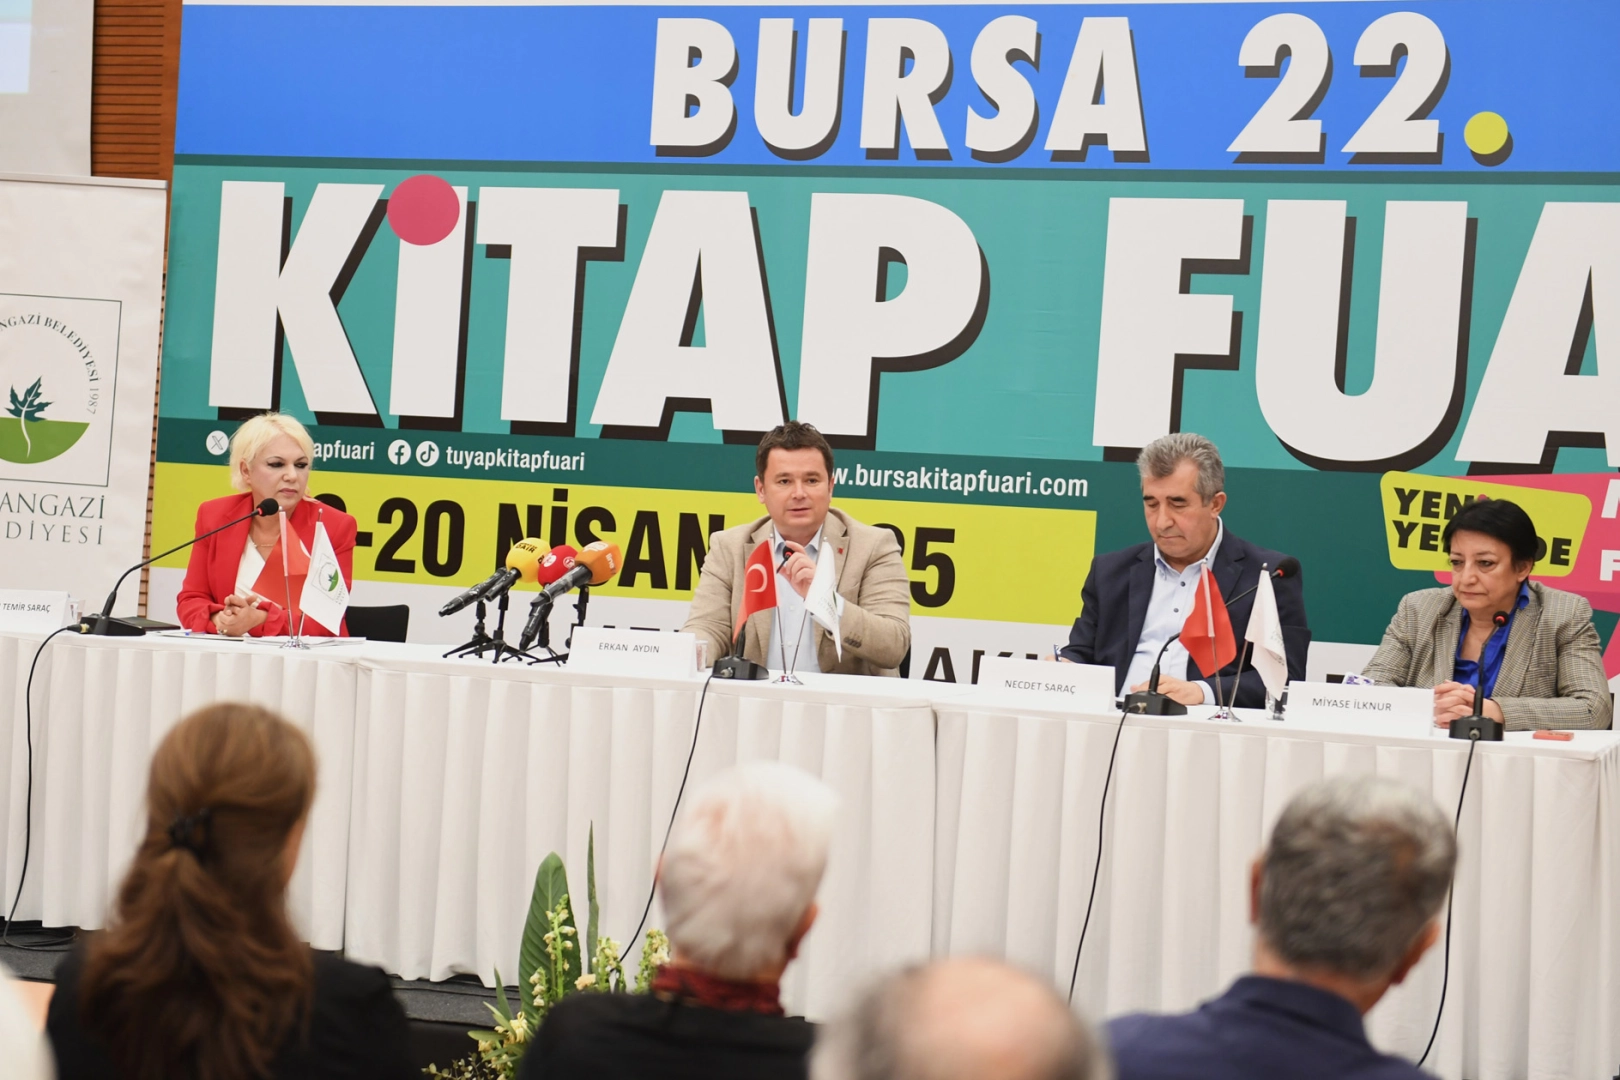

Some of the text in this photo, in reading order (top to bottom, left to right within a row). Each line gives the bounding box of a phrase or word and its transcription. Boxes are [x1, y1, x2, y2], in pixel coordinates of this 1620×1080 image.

[650, 11, 1512, 165] BURSA 22.
[209, 174, 989, 449] KİTAP
[44, 316, 102, 382] BELEDİYESİ
[87, 387, 99, 415] 1987
[313, 440, 375, 462] apfuari
[446, 446, 585, 473] tuyapkitapfuari
[834, 463, 1088, 498] w.bursakitapfuari.com
[494, 488, 725, 591] NİSAN
[3, 602, 51, 613] TEMİR SARAÇ
[598, 642, 660, 654] ERKAN AYDIN
[1004, 679, 1077, 695] NECDET SARAÇ
[1312, 697, 1392, 711] MİYASE İLKNUR
